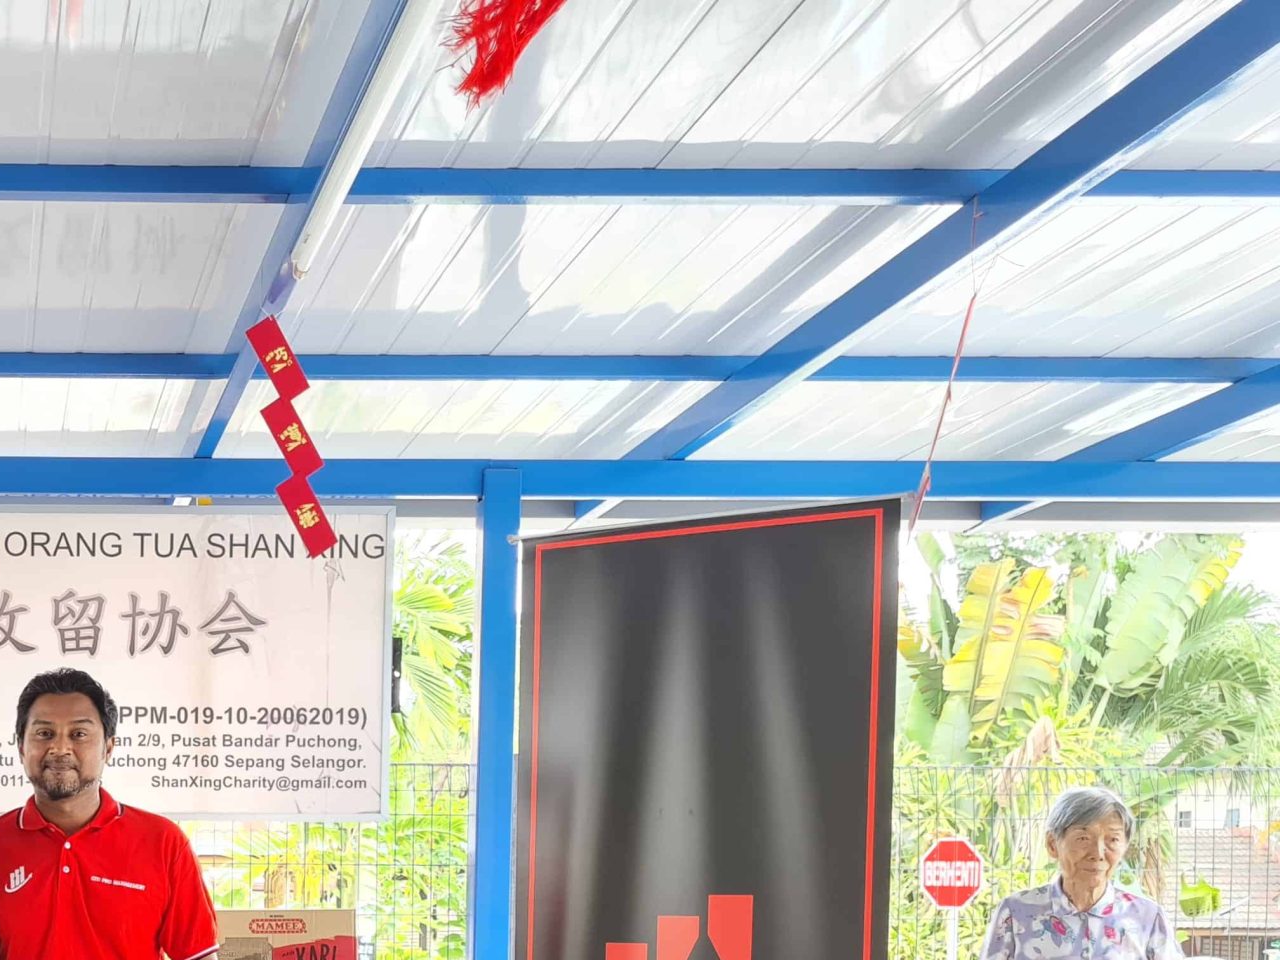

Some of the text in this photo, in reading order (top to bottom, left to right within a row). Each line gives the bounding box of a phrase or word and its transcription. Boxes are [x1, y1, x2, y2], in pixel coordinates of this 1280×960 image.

[4, 531, 122, 558] ORANG
[132, 532, 198, 558] TUA
[206, 533, 295, 559] SHAN
[137, 733, 165, 749] 2/9,
[171, 734, 217, 748] Pusat
[222, 734, 280, 748] Bandar
[286, 735, 362, 752] Puchong,
[108, 754, 167, 771] uchong
[172, 755, 219, 768] 47160
[224, 755, 285, 771] Sepang
[291, 755, 367, 772] Selangor.
[151, 775, 367, 792] ShanXingCharity@gmail.com
[924, 860, 979, 887] BERHENTI
[255, 922, 301, 931] MAMEE
